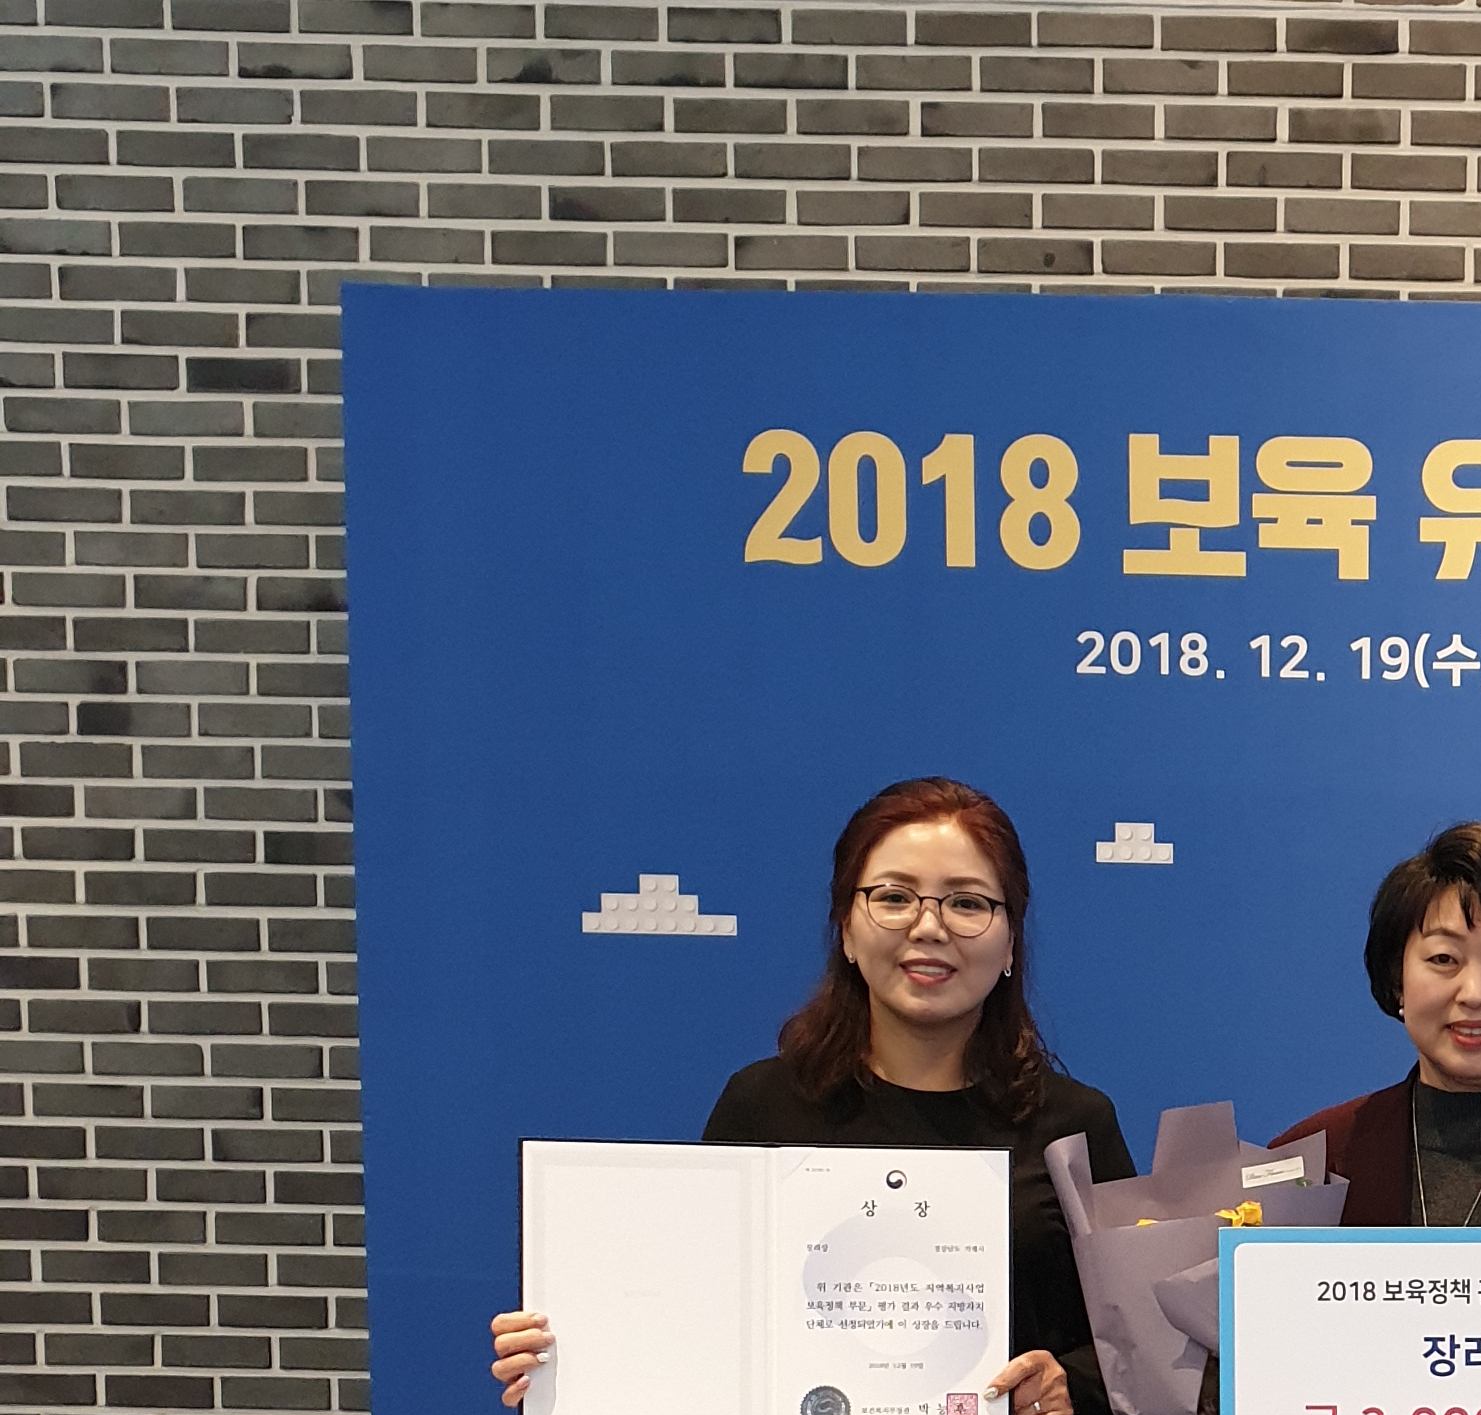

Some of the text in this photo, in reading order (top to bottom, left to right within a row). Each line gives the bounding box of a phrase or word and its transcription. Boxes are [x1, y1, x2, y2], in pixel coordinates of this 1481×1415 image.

[744, 431, 1081, 570] 2018
[1124, 435, 1377, 580] 보육
[1077, 632, 1226, 680] 2018.
[1250, 636, 1327, 683] 12.
[861, 1200, 930, 1218] 상 장
[817, 1282, 826, 1293] 위
[832, 1282, 863, 1293] 기관은
[1318, 1282, 1377, 1303] 2018
[1383, 1279, 1472, 1306] 보육정책
[806, 1301, 843, 1311] 보육정책
[877, 1301, 895, 1311] 평가
[901, 1301, 919, 1311] 결과
[924, 1301, 943, 1311] 우수
[948, 1301, 985, 1312] 지방자치
[806, 1319, 834, 1330] 단체로
[897, 1320, 907, 1330] 이
[912, 1320, 940, 1330] 상장을
[918, 1403, 930, 1415] 박
